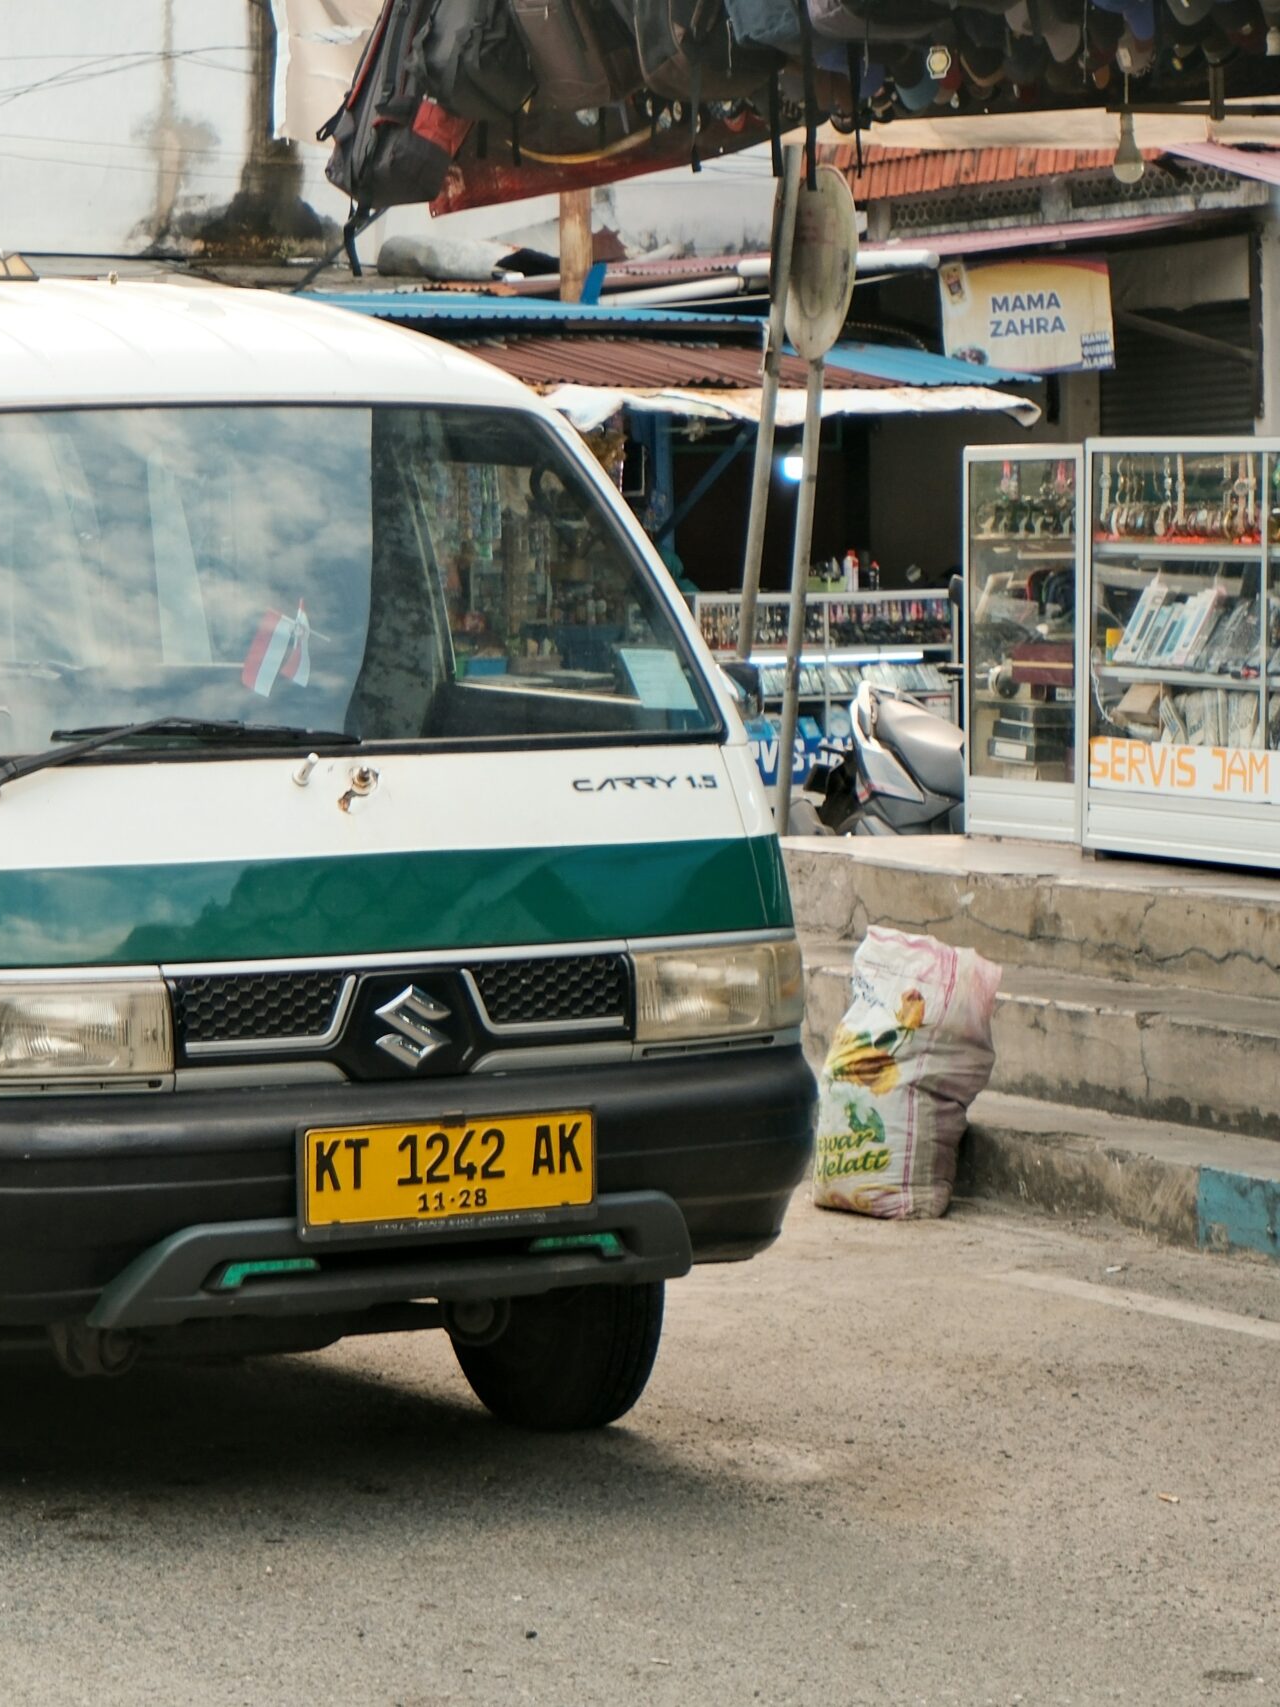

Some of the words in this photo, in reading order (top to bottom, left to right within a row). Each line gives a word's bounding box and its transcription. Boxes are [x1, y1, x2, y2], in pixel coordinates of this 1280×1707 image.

[991, 292, 1061, 313] MAMA
[989, 315, 1066, 338] ZAHRA
[1212, 746, 1269, 794] JAM
[572, 775, 677, 792] CARRY
[685, 774, 718, 789] 1.5
[315, 1138, 370, 1192] KT
[396, 1128, 506, 1186] 1242
[532, 1122, 583, 1176] AK
